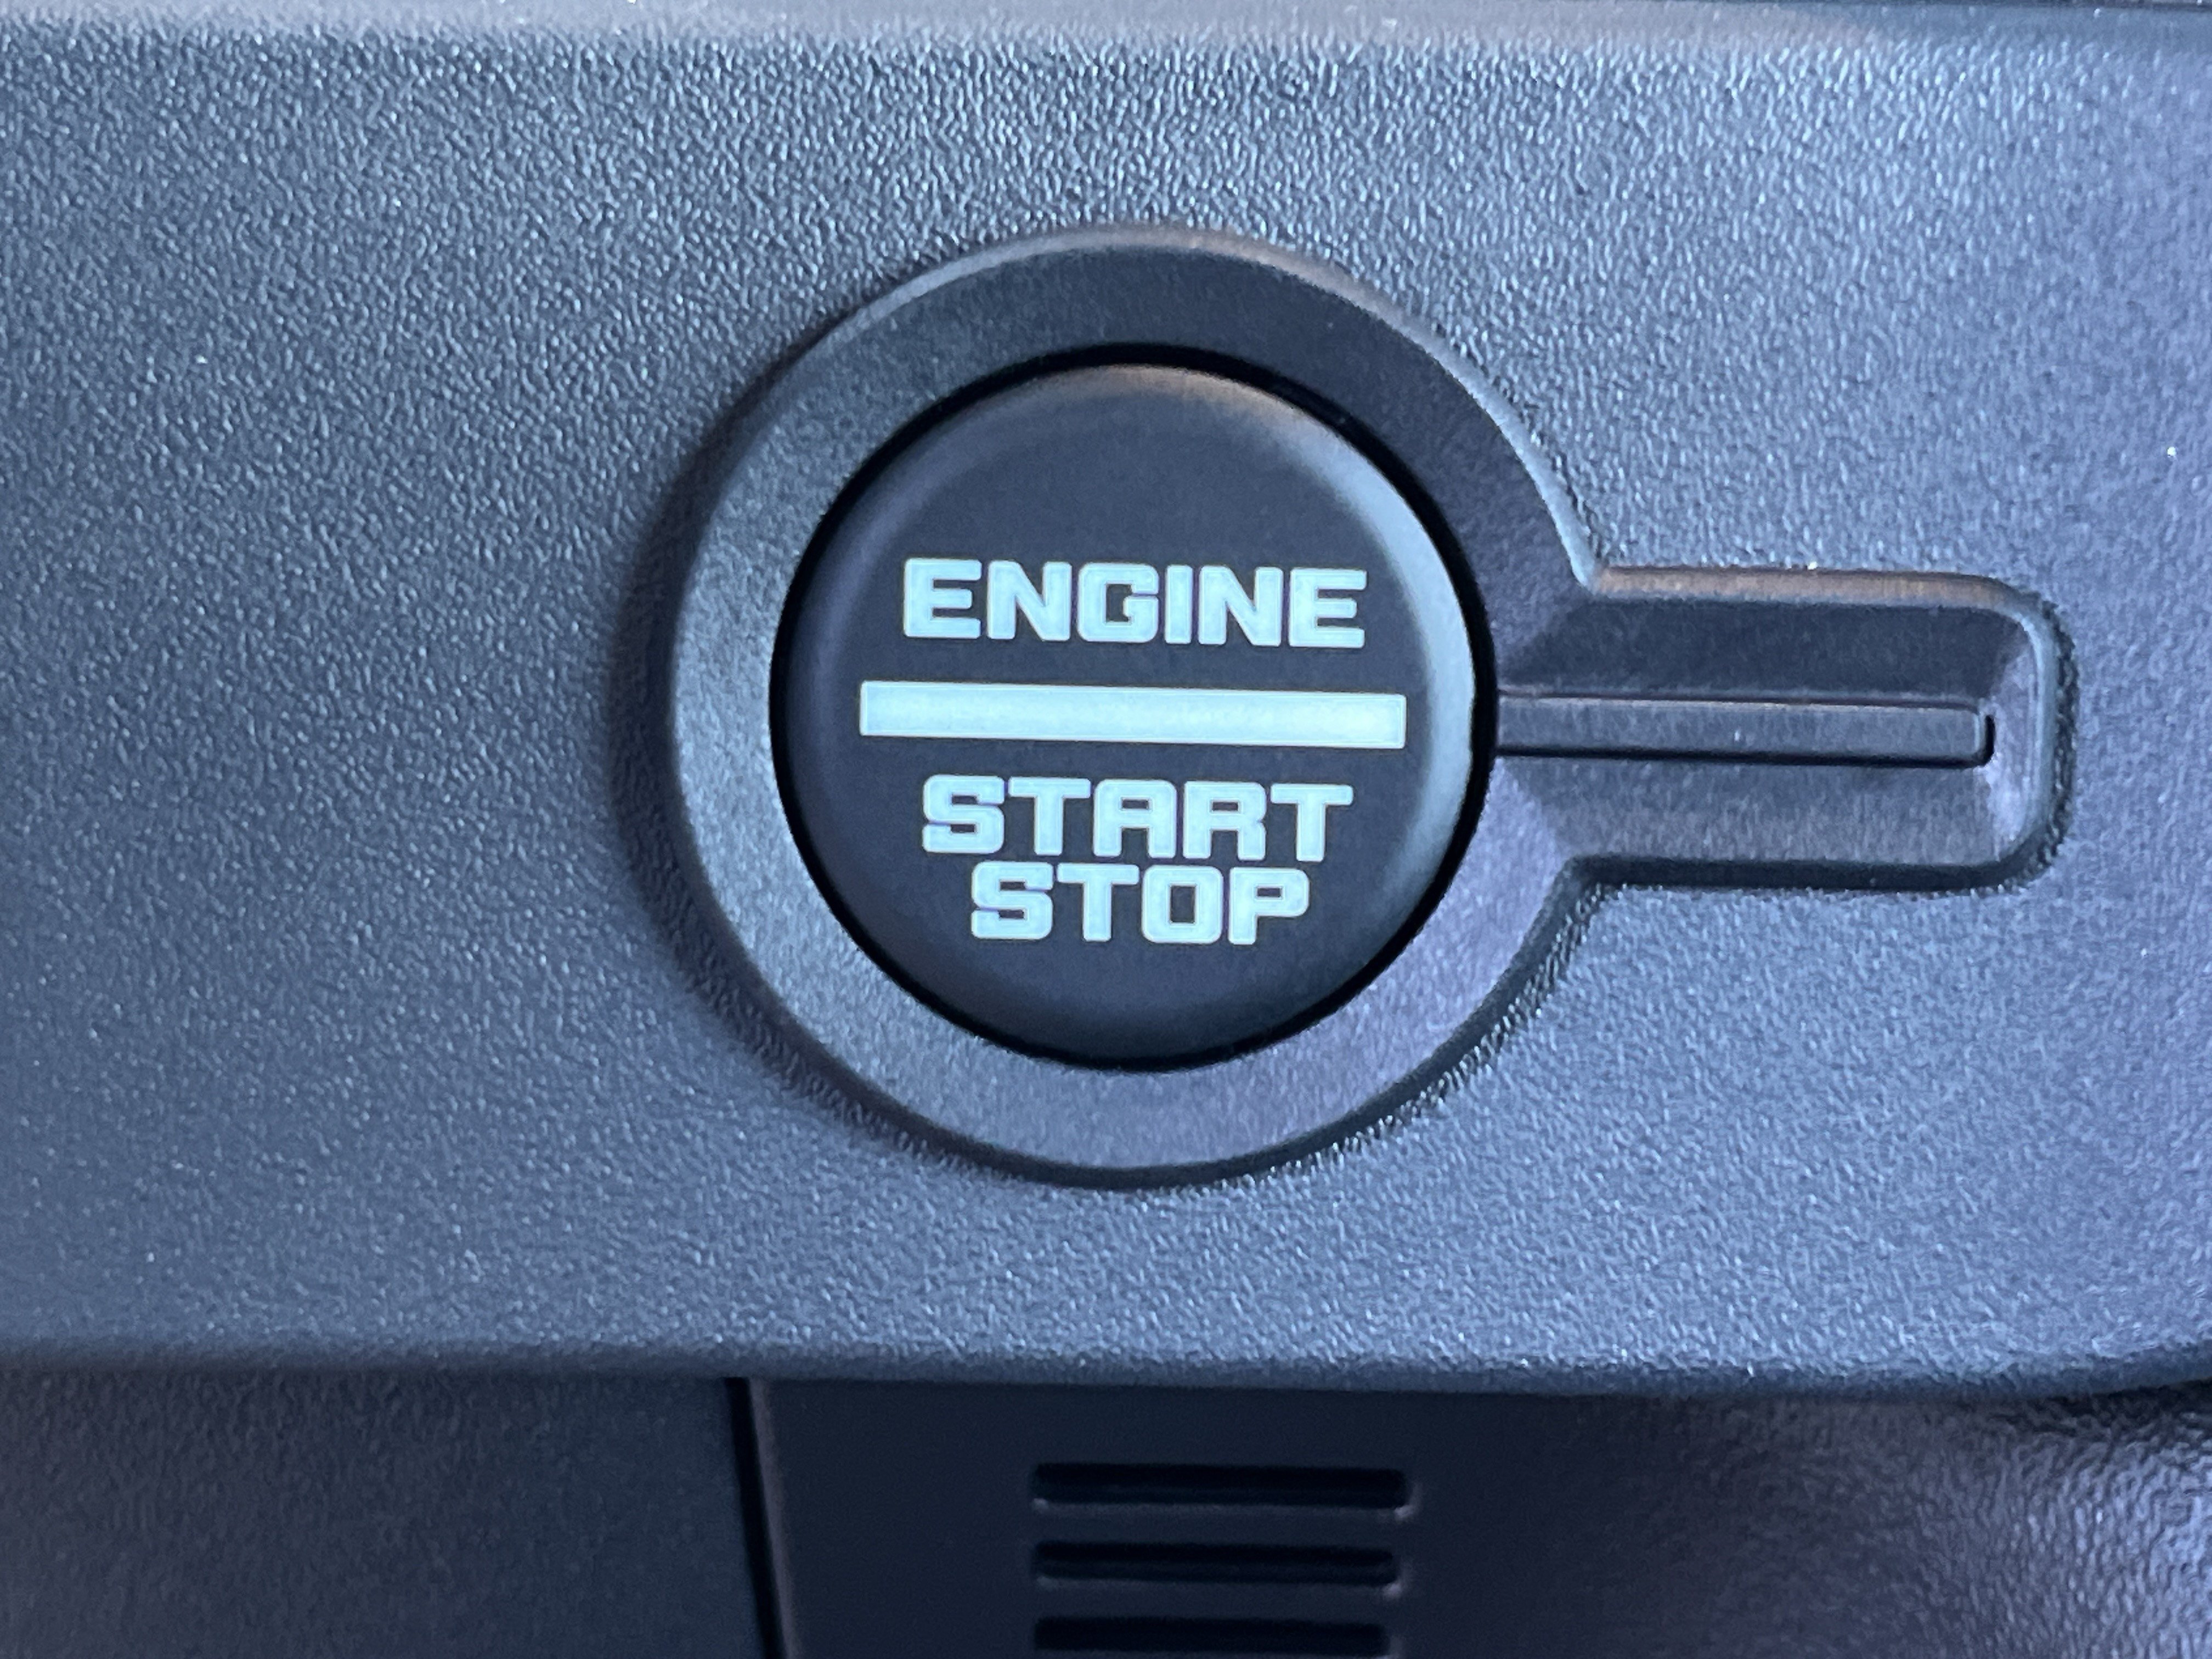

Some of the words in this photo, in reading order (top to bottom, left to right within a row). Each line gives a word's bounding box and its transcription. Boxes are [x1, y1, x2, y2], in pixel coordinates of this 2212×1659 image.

[902, 557, 1368, 649] ENGINE
[921, 774, 1354, 863] START
[970, 860, 1310, 946] STOP
